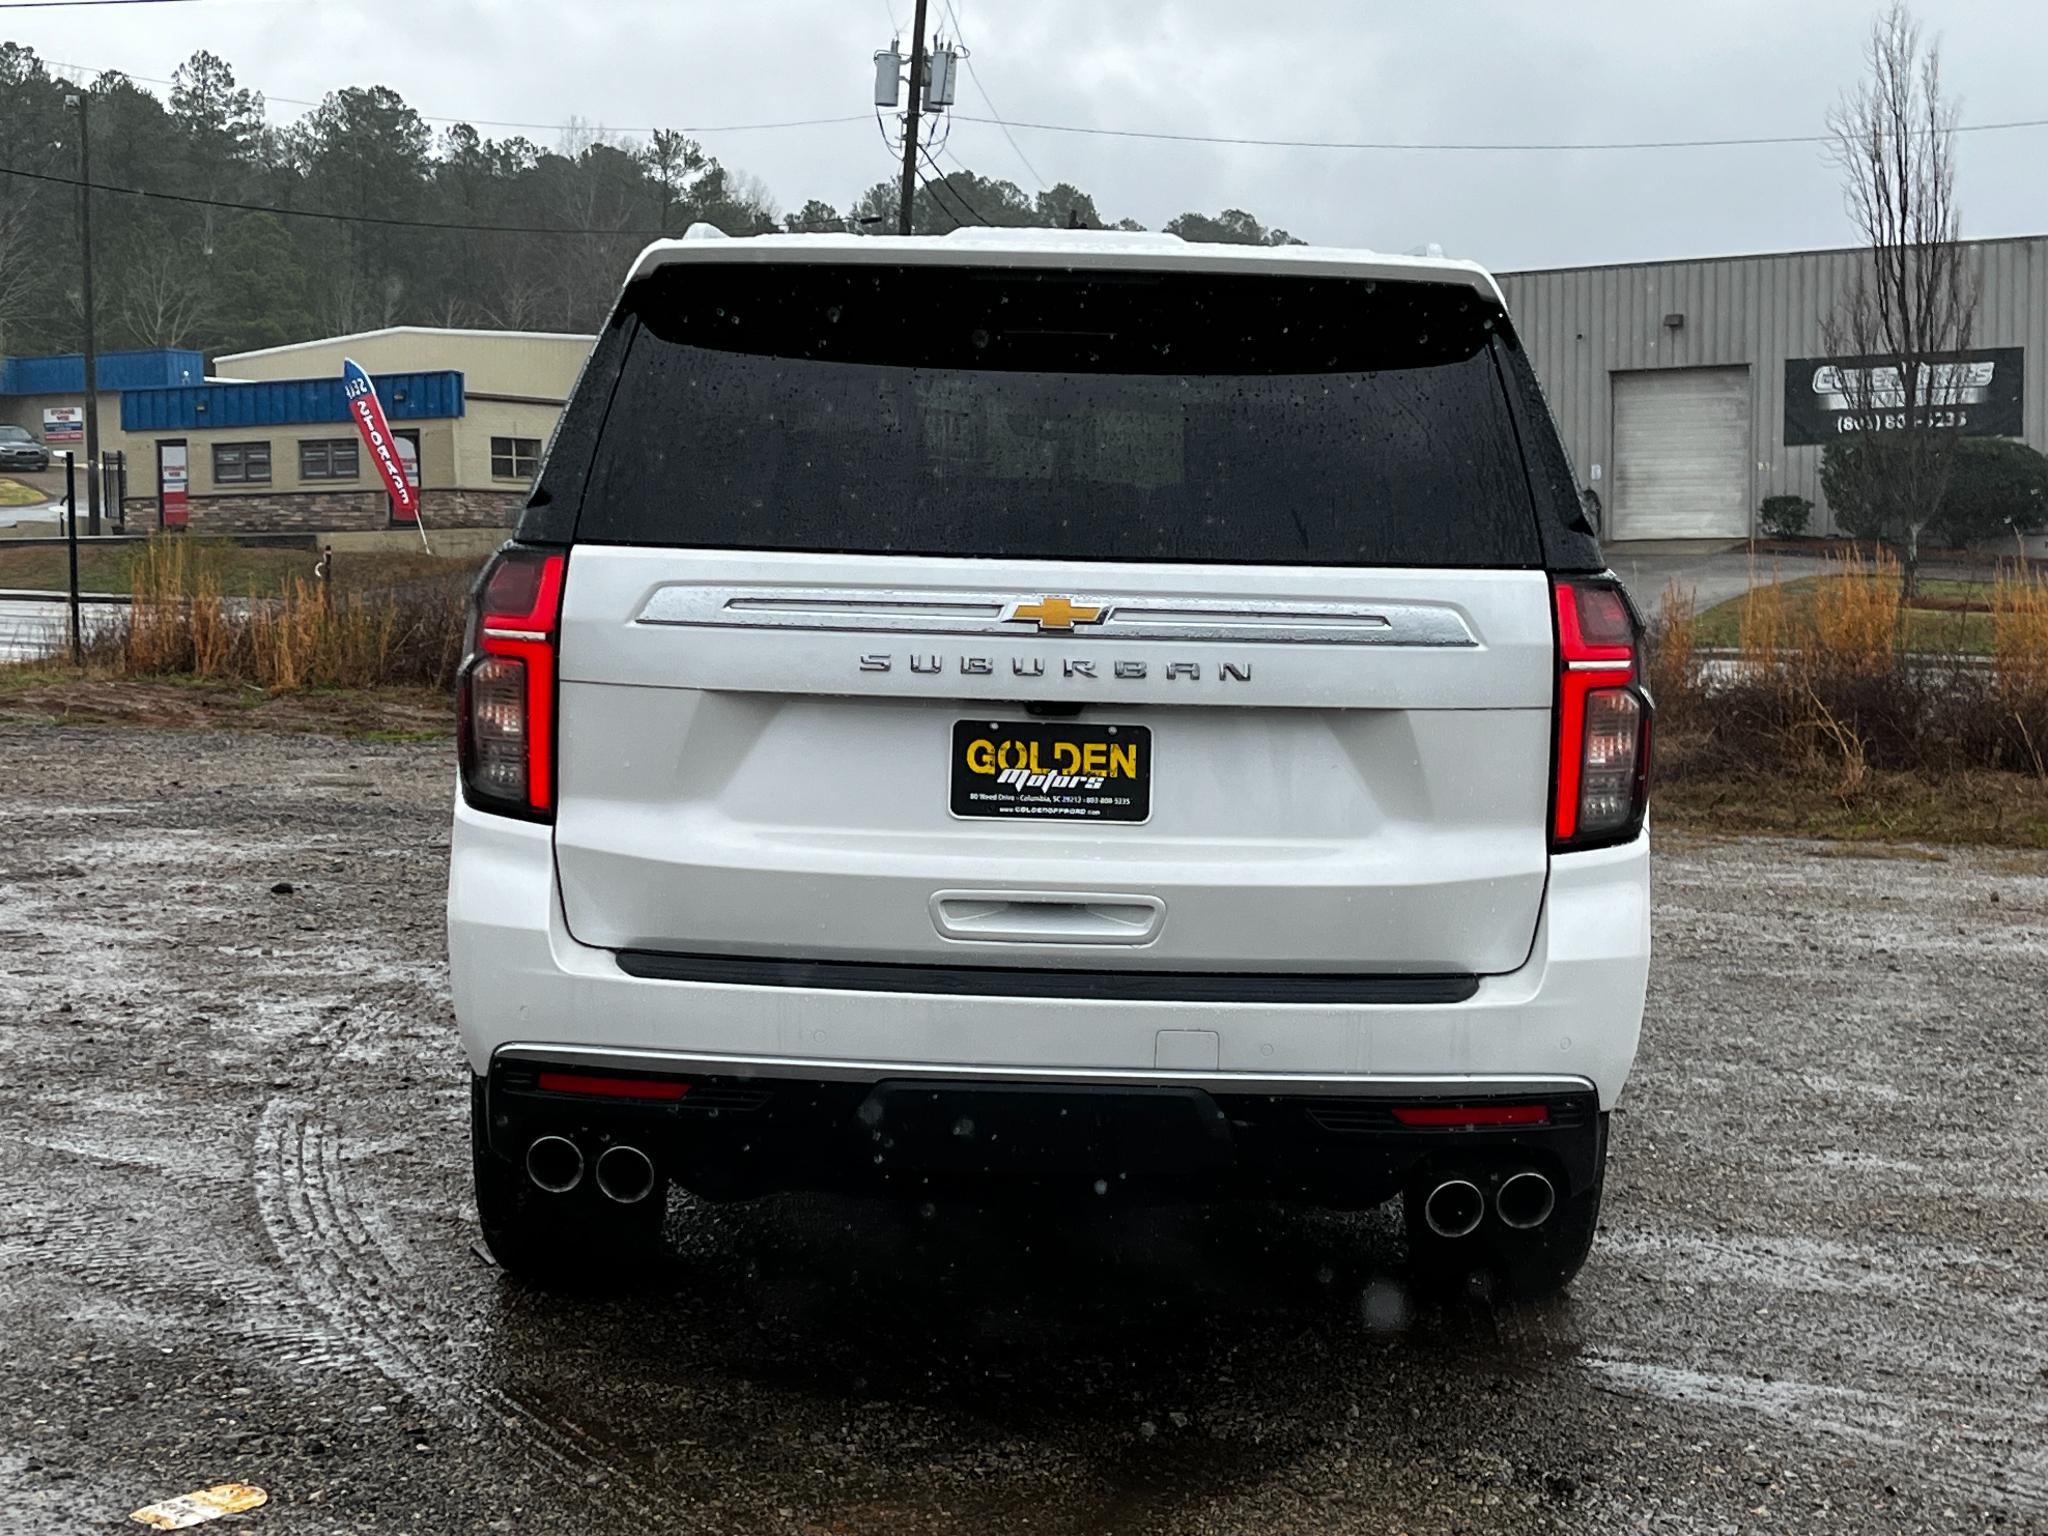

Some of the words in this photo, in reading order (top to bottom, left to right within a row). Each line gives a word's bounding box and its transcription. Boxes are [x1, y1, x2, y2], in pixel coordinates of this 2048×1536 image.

[858, 653, 1252, 682] SUBURBAN
[966, 738, 1137, 779] GOLDEN
[996, 767, 1105, 794] Motors
[1052, 795, 1061, 803] SC
